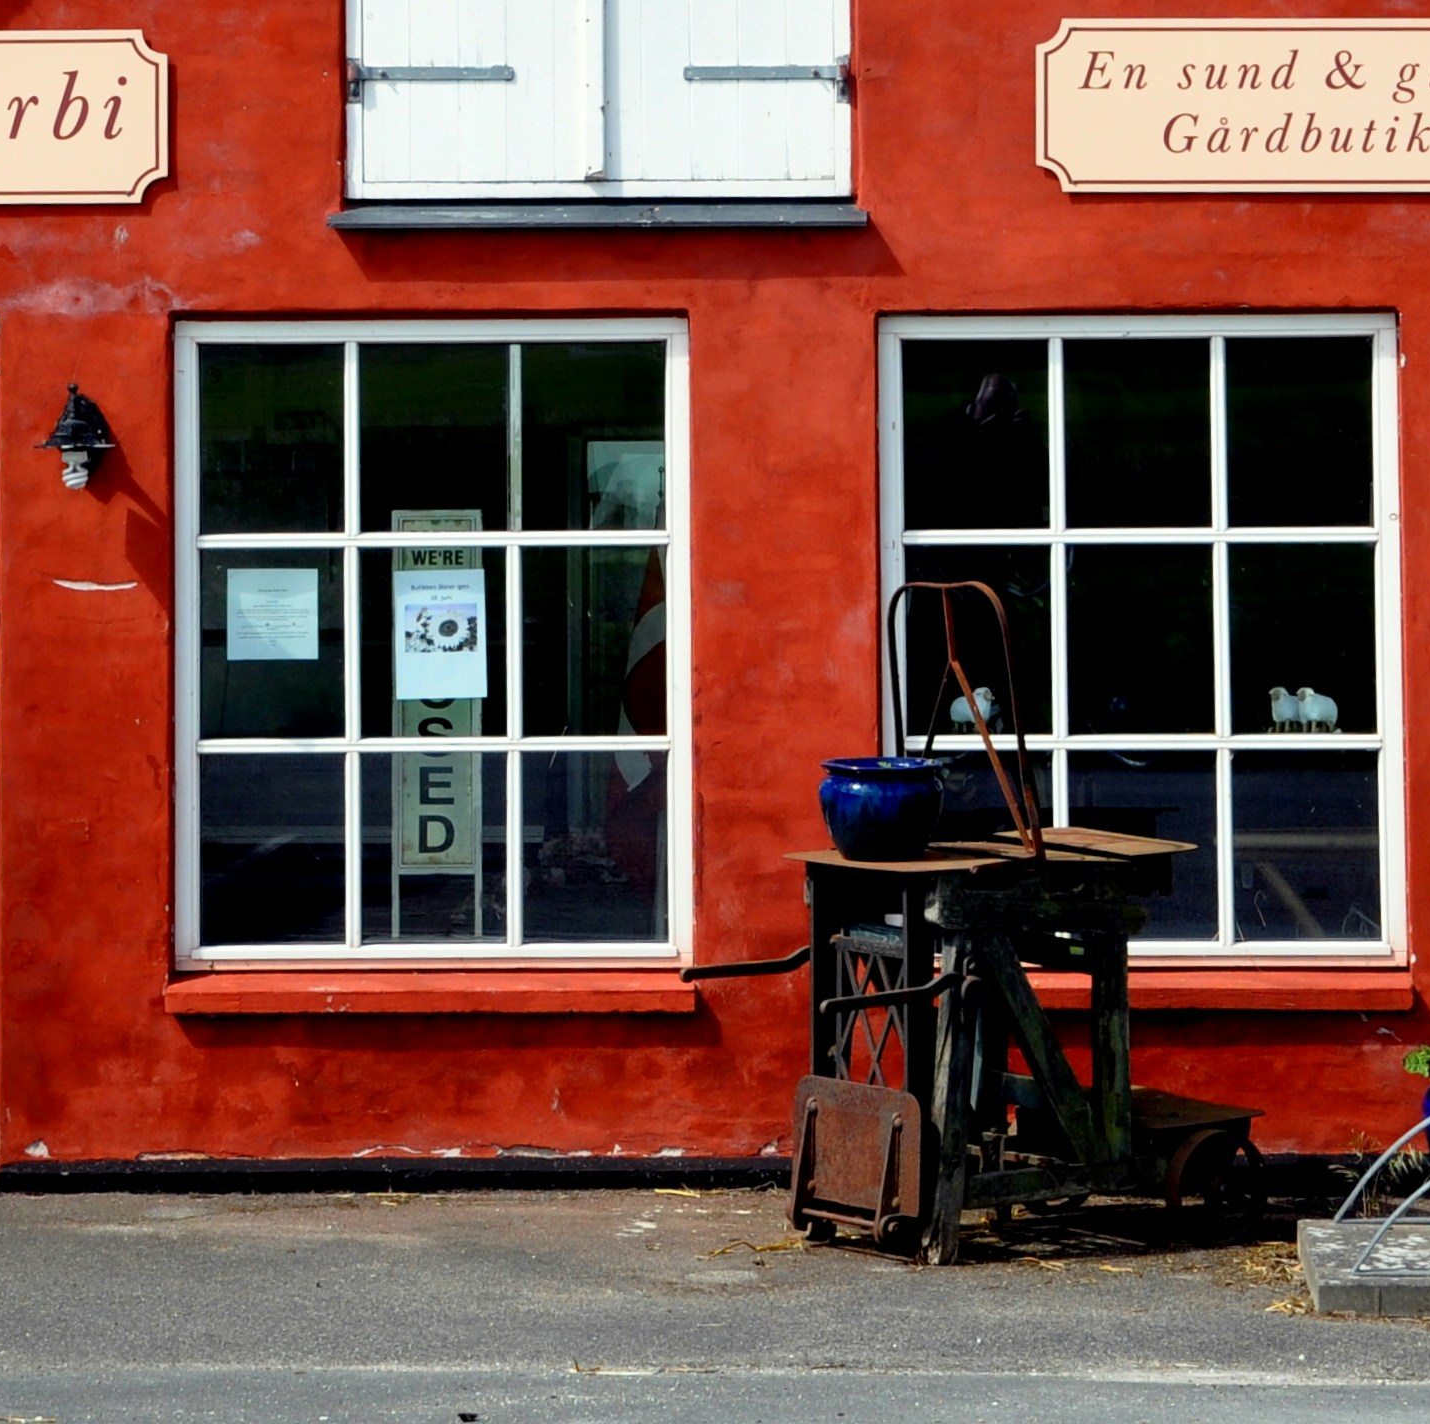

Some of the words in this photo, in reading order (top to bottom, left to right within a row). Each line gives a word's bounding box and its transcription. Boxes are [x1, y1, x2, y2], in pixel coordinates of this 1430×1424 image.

[1079, 51, 1147, 89] En
[1177, 49, 1299, 89] sund
[1325, 50, 1366, 89] &
[1164, 112, 1430, 153] Gårdbutik
[412, 550, 464, 565] WE'RE
